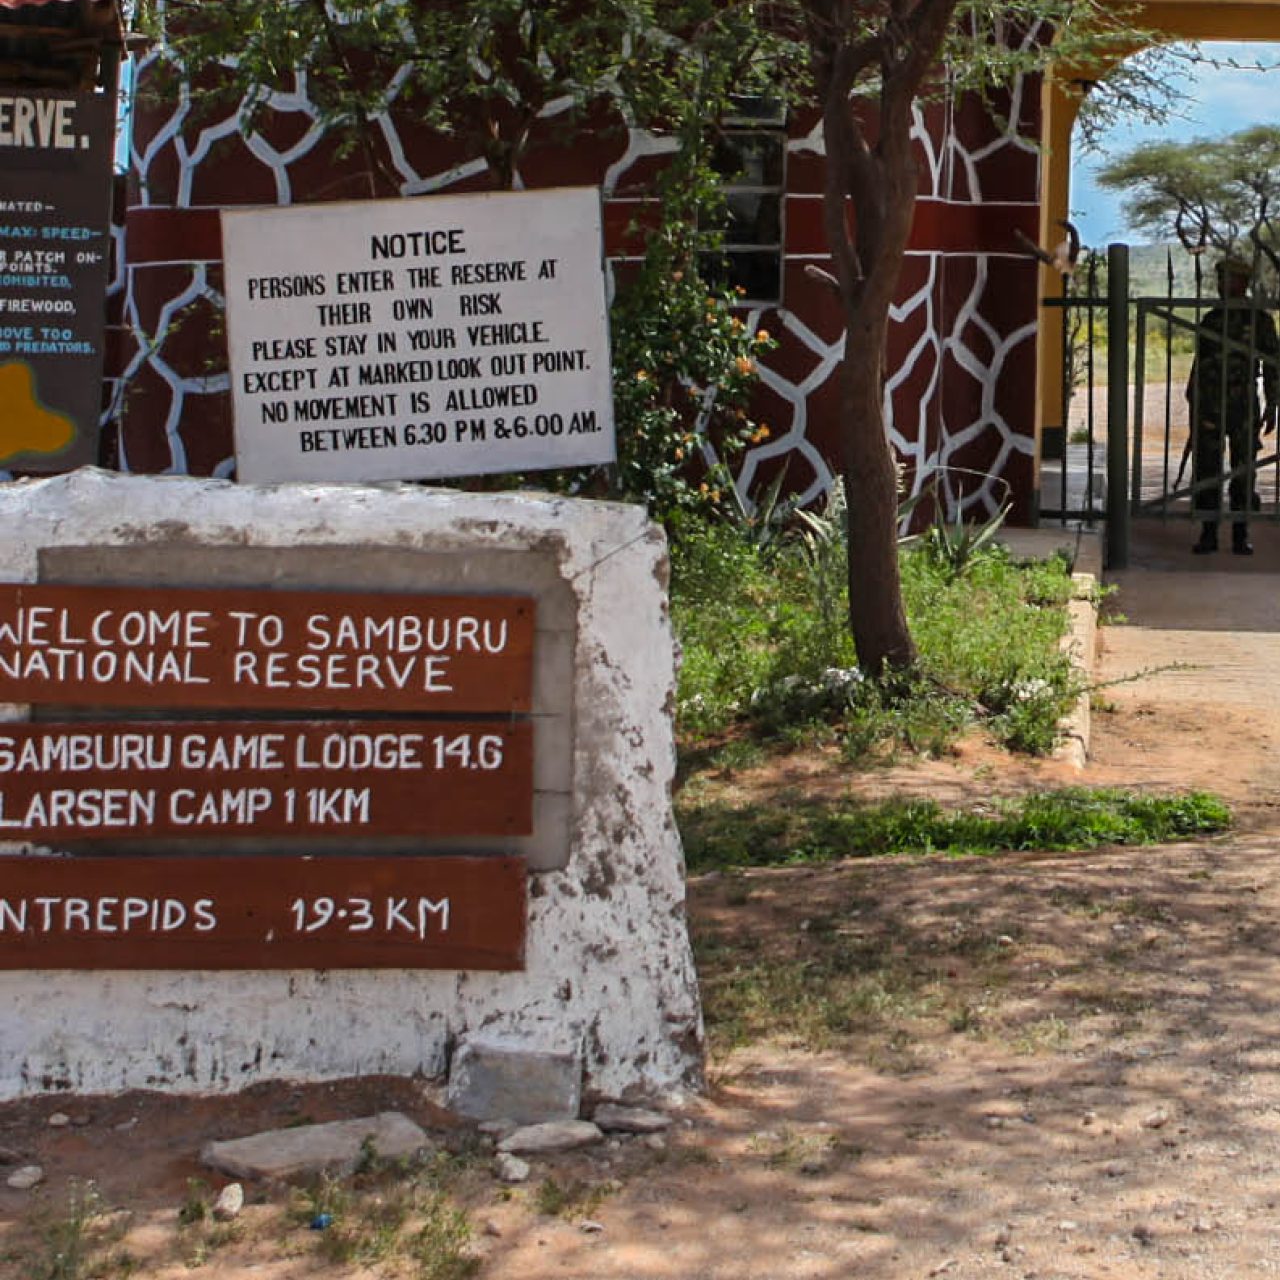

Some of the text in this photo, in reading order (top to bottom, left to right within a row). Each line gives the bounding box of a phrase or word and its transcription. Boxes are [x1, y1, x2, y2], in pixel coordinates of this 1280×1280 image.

[0, 97, 90, 150] ERVE.
[14, 250, 66, 264] PATCH
[371, 229, 466, 261] NOTICE
[248, 259, 557, 301] PERSONS ENTER THE RESERVE AT
[318, 293, 503, 328] THEIR OWN RISK
[40, 328, 73, 341] TOO
[252, 338, 317, 362] PLEASE
[325, 334, 367, 357] STAY
[377, 331, 397, 354] IN
[407, 328, 457, 351] YOUR
[243, 349, 591, 394] EXCEPT AT MARKED LOOK OUT POINT.
[261, 384, 538, 425] NO MOVEMENT IS ALLOWED
[301, 425, 397, 453] BETWEEN
[403, 422, 447, 446] 6.30
[455, 418, 486, 442] PM
[568, 410, 602, 435] AM.
[0, 607, 508, 654] WELCOME TO SAMBURU
[0, 648, 453, 692] NATIONAL RESERVE
[0, 733, 504, 772] SAMBURU GAME LODGE 14.6
[0, 788, 156, 828] LARSEN
[169, 787, 273, 826] CAMP
[0, 896, 217, 933] NTREPIDS
[386, 896, 450, 940] KM
